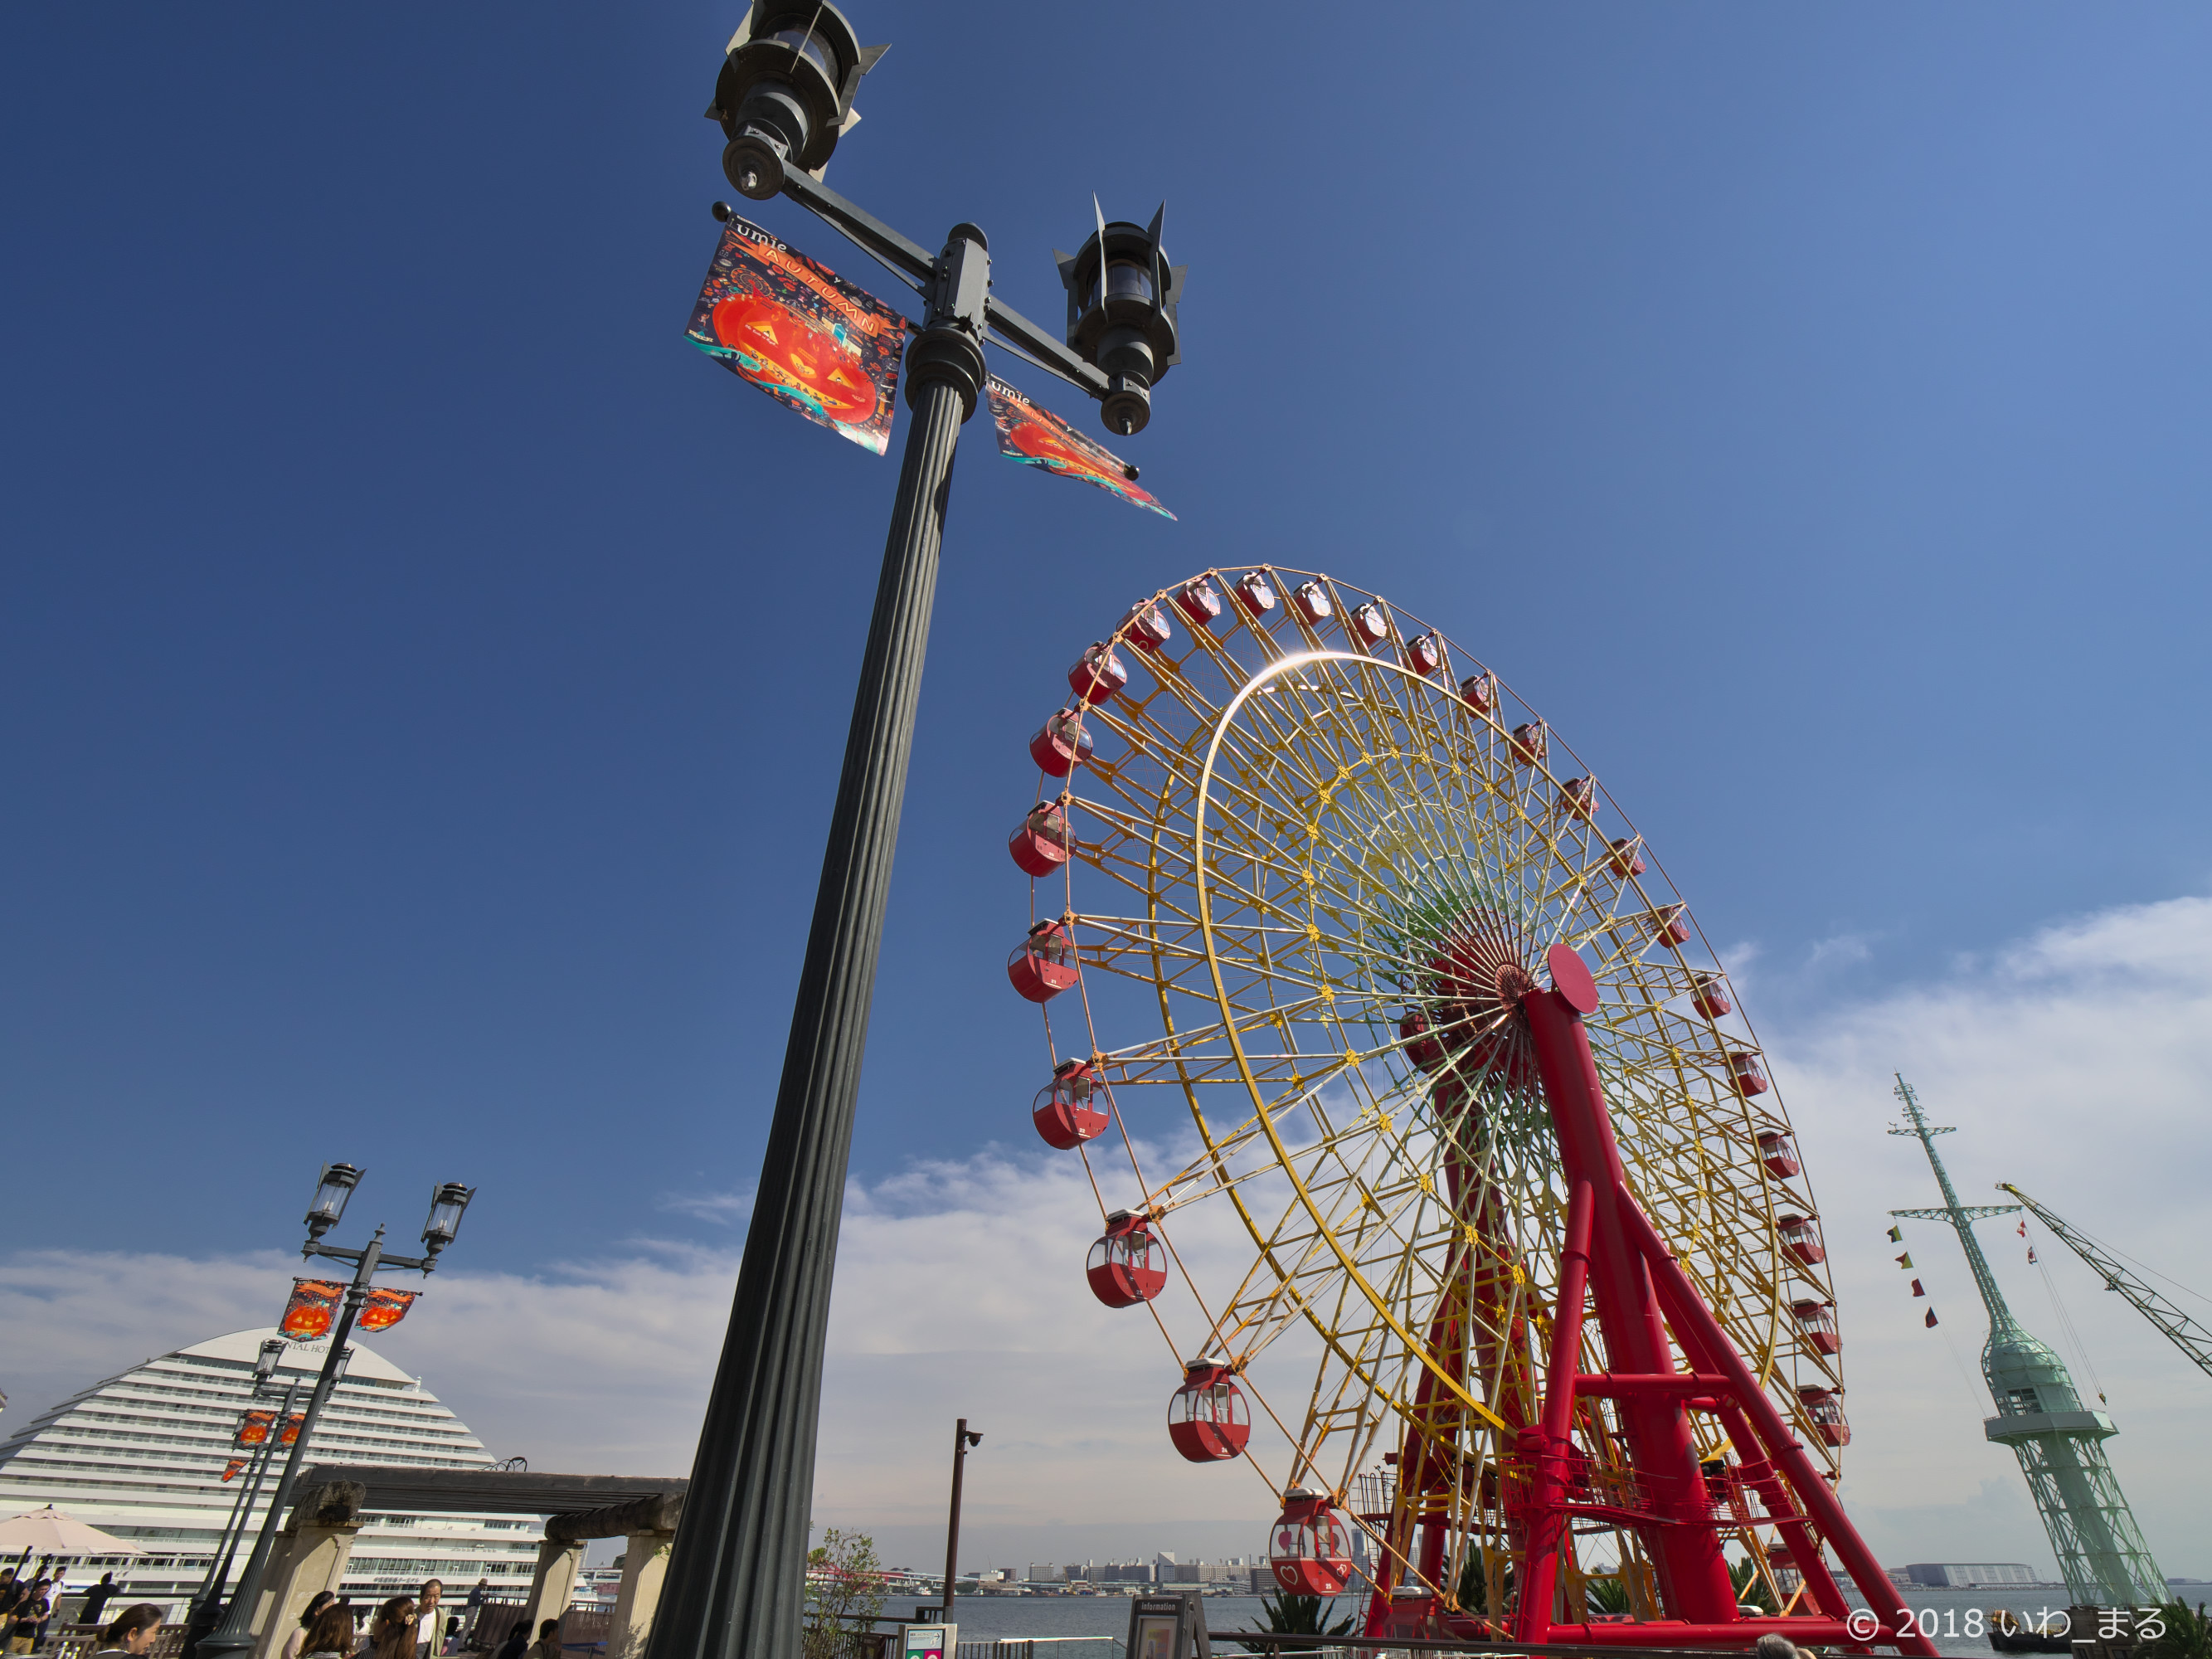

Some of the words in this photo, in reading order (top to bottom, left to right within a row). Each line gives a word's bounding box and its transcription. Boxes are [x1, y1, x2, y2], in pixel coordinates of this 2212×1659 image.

[737, 223, 787, 253] umie
[766, 250, 875, 332] AUTUMN
[991, 380, 1030, 406] umie
[1141, 1601, 1176, 1611] Information
